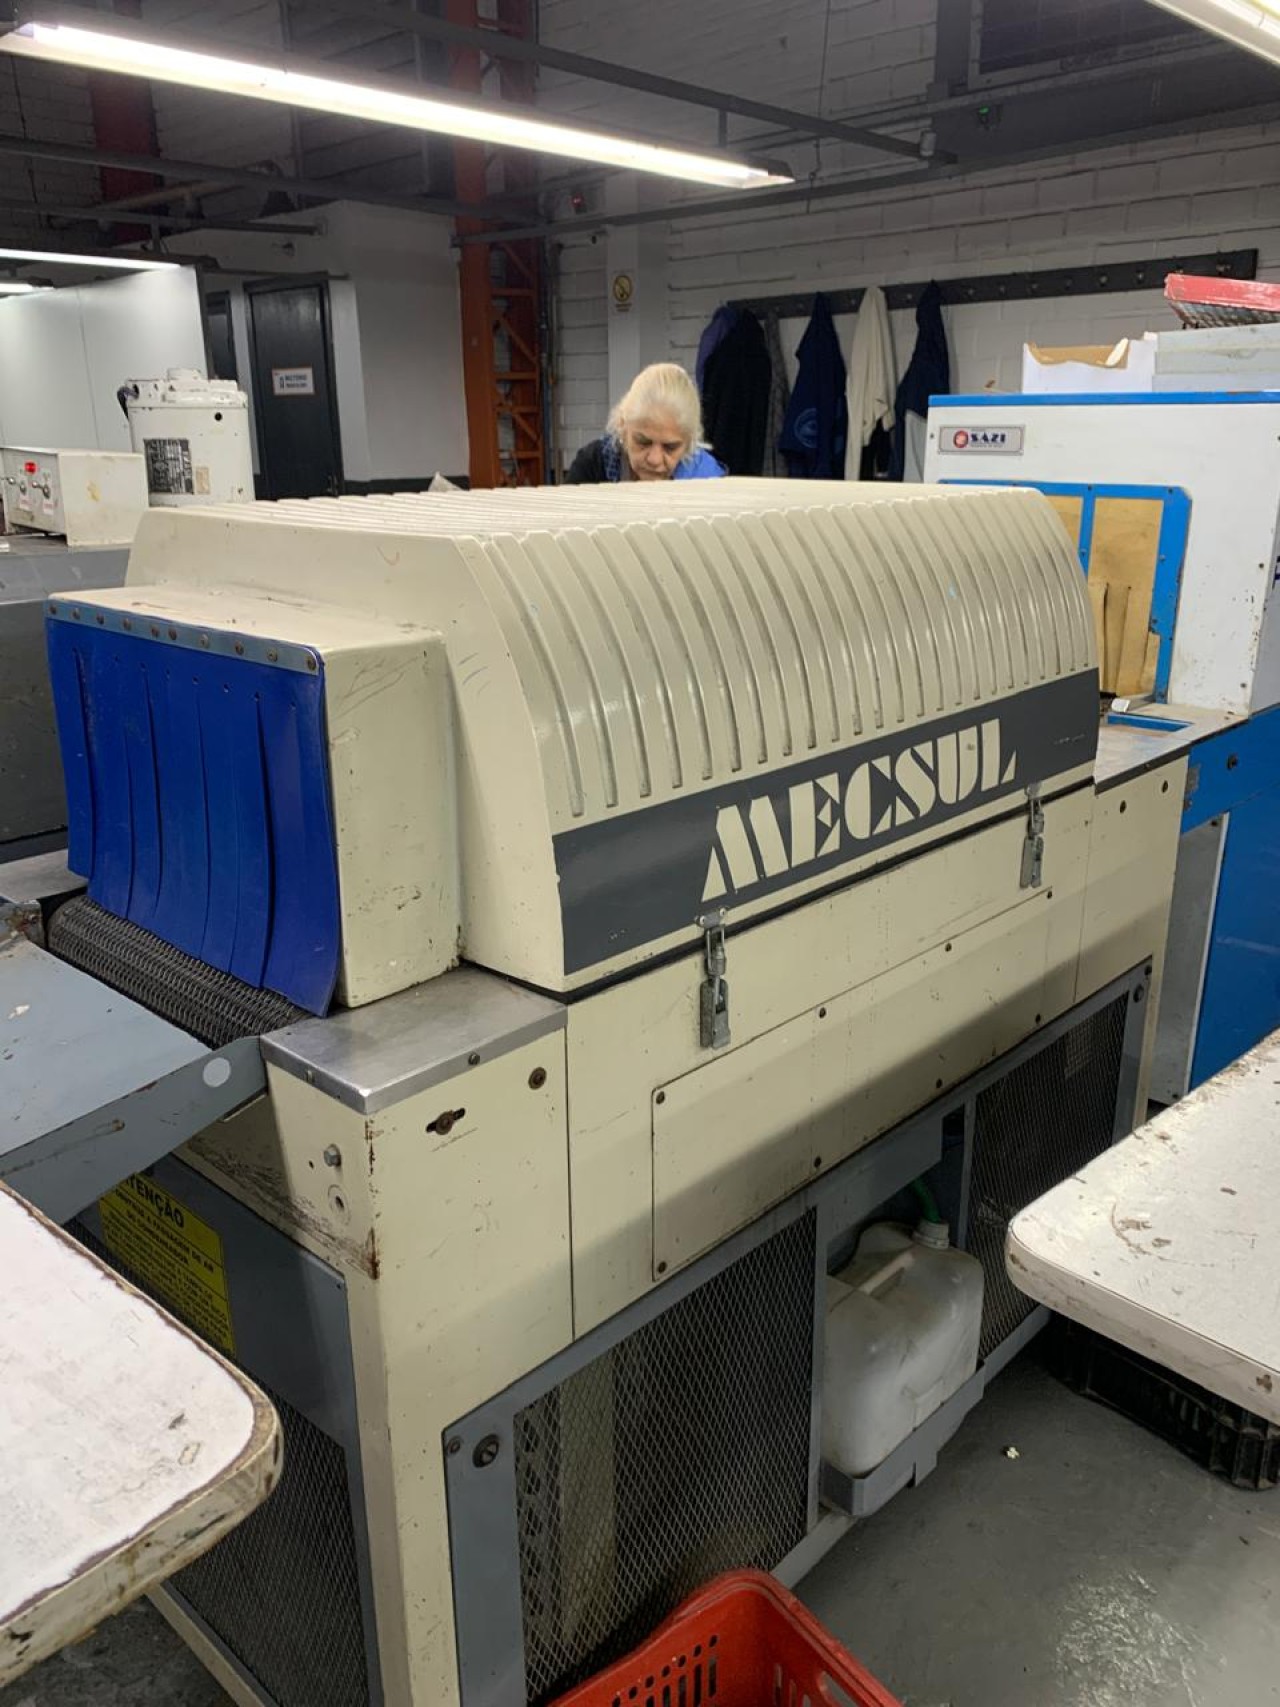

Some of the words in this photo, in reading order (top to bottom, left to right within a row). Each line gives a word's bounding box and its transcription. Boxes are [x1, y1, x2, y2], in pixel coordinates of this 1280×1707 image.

[970, 432, 1006, 443] SAZI
[701, 718, 1017, 902] MECSUL
[125, 1174, 184, 1228] TENÇÃO
